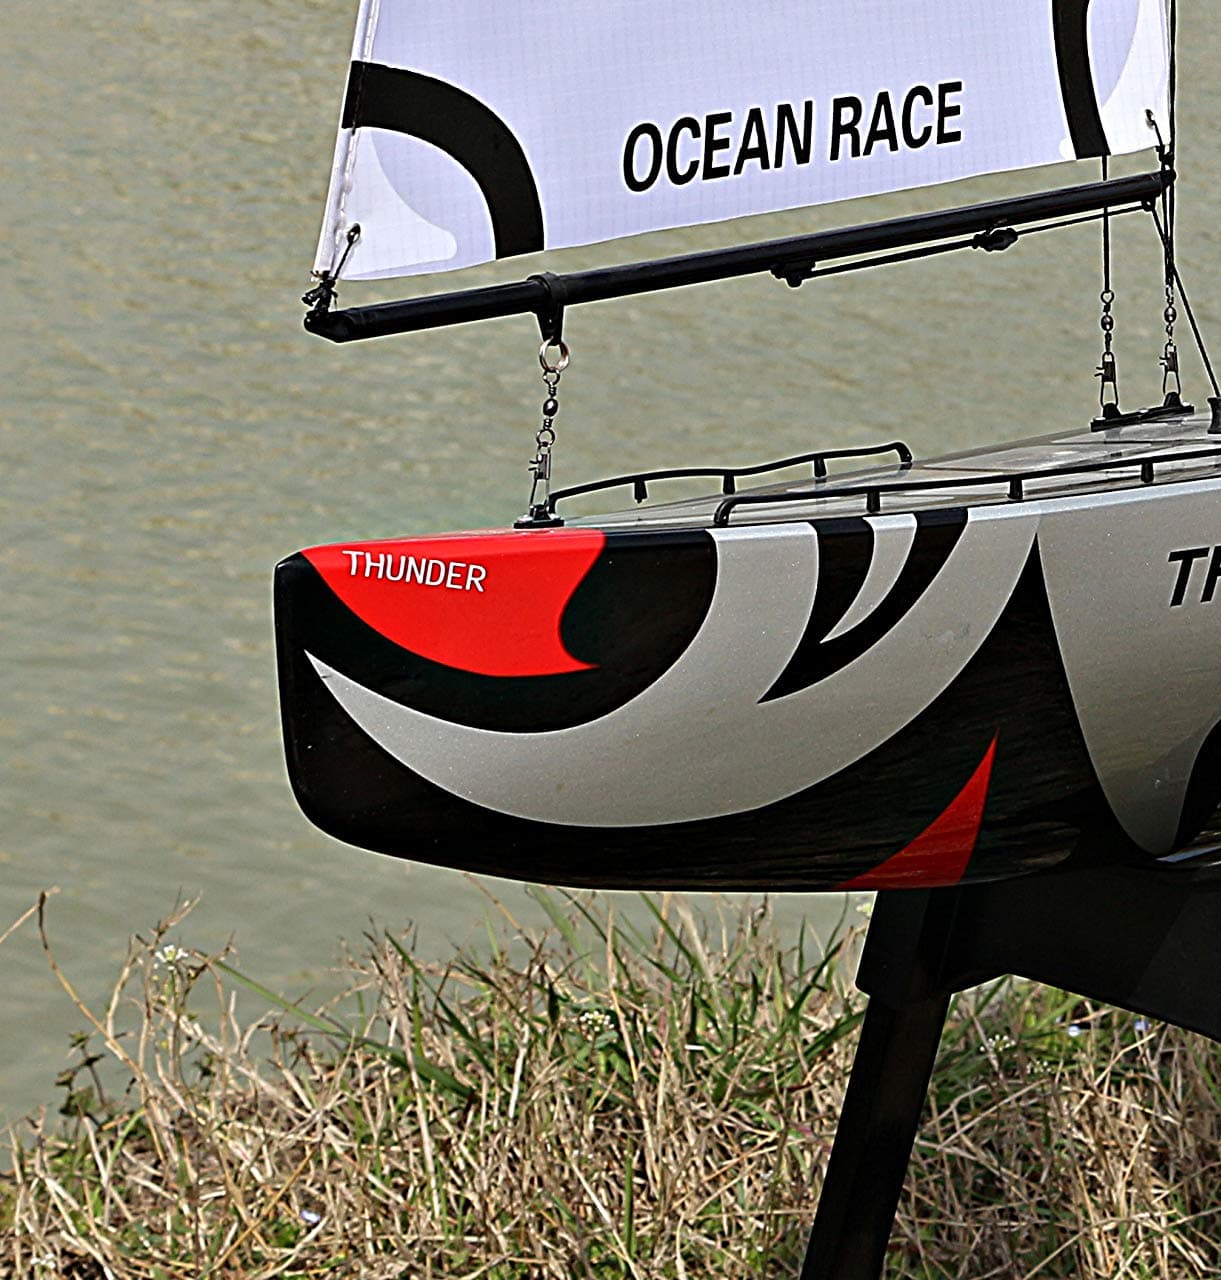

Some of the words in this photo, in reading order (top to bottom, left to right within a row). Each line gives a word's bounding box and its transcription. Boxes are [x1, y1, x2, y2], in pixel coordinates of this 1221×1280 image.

[622, 100, 814, 193] OCEAN
[829, 80, 963, 162] RACE
[342, 549, 488, 593] THUNDER
